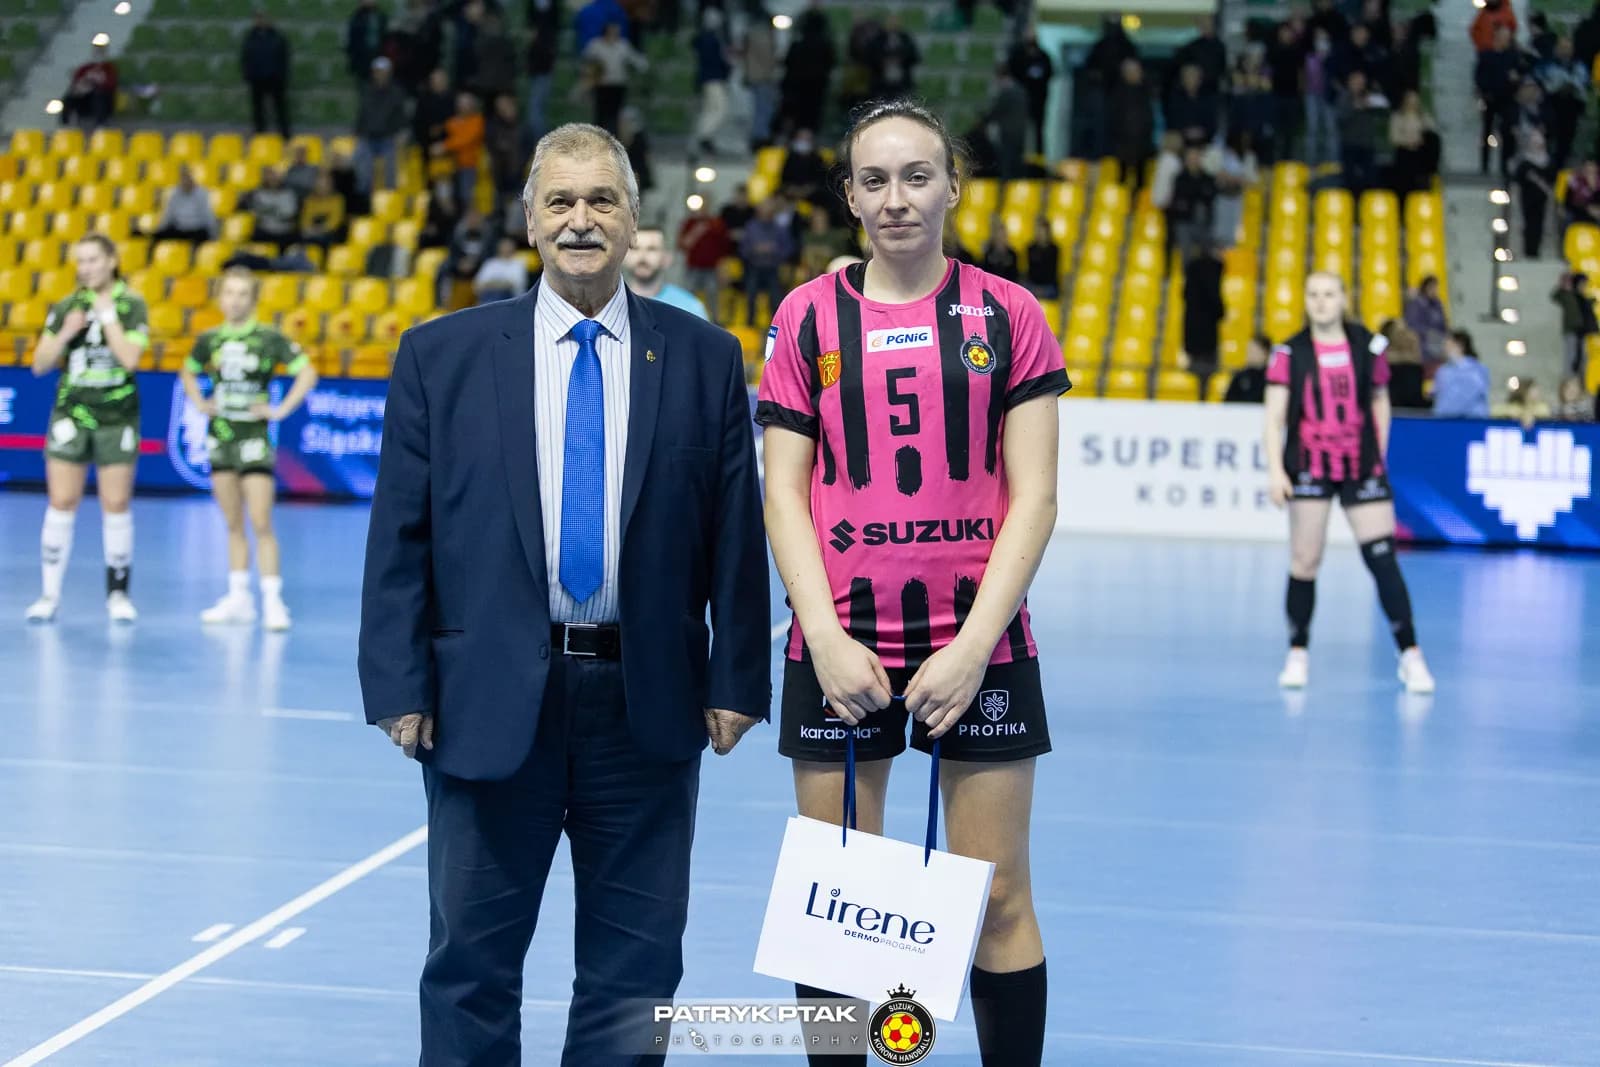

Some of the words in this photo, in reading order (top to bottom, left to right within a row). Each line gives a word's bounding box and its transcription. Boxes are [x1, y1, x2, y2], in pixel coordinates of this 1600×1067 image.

[886, 332, 928, 345] PGNiG
[885, 366, 921, 436] 5
[1081, 434, 1270, 471] SUPERL
[1137, 483, 1268, 508] KOBIE
[862, 518, 994, 546] SUZUKI
[958, 722, 1027, 736] PROFIKA
[805, 881, 936, 945] Lirene
